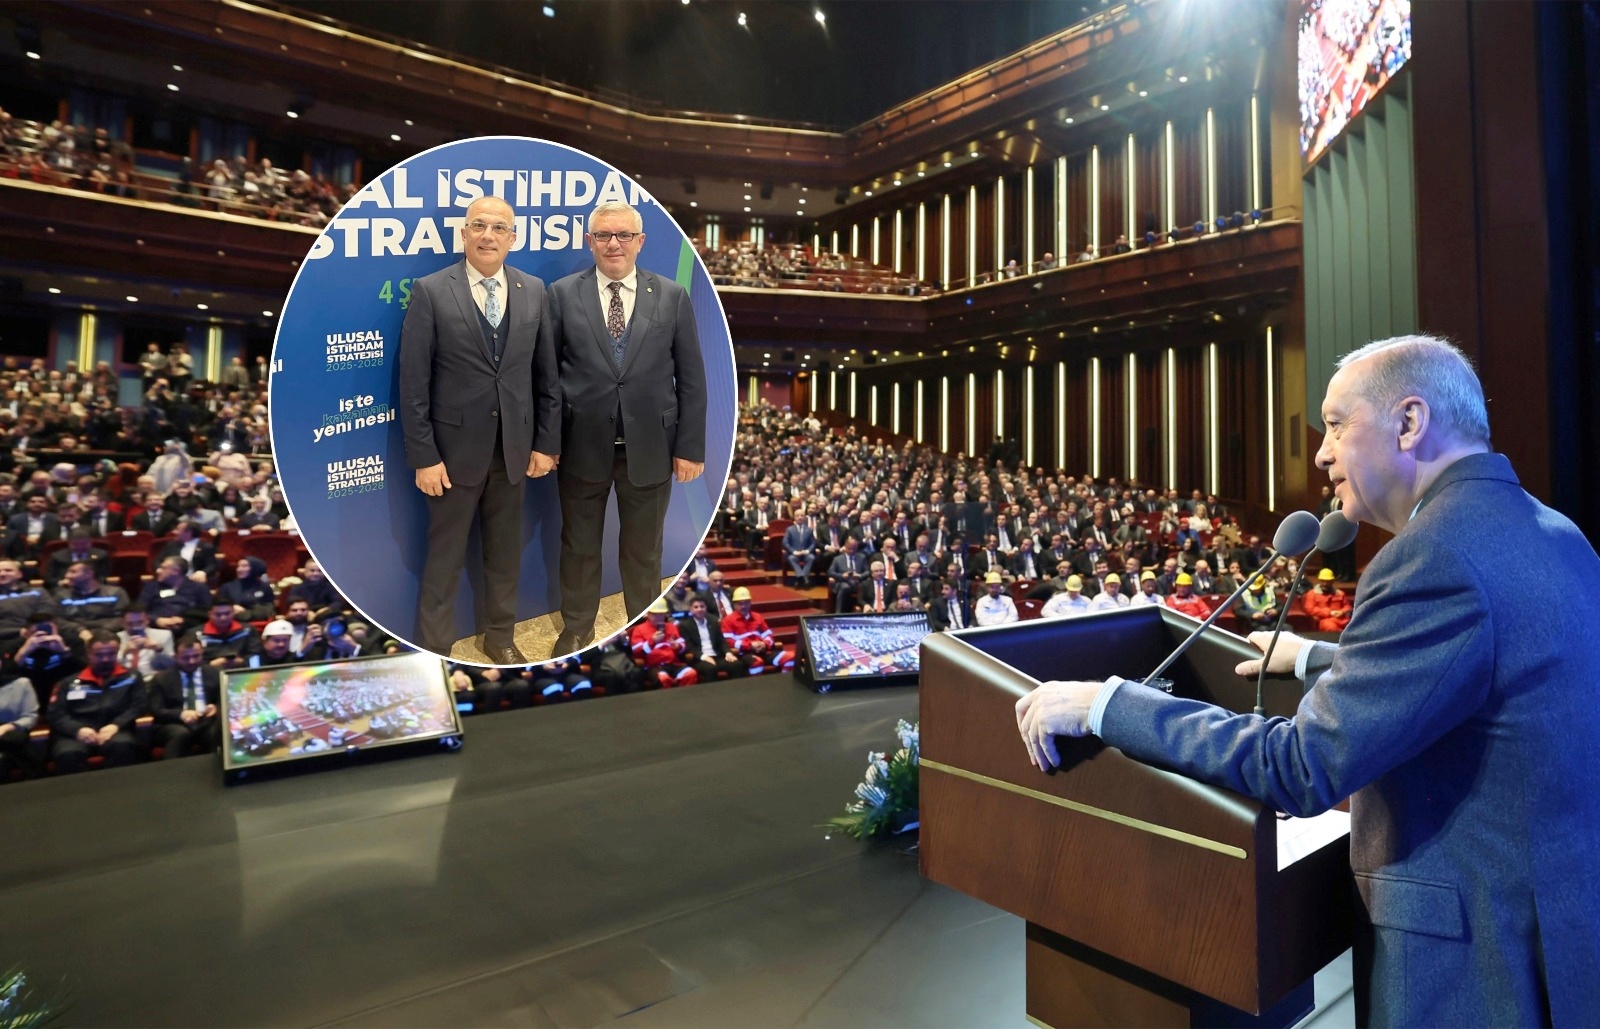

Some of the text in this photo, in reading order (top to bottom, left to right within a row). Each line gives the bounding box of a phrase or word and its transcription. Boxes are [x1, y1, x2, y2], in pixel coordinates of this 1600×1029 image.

[308, 215, 584, 260] STRATJİSİ
[379, 279, 418, 310] 4 Ş
[326, 330, 383, 345] ULUSAL
[326, 358, 384, 372] 2025-2028
[313, 408, 396, 443] yeni nesil
[321, 403, 389, 427] kazanan
[327, 454, 384, 473] ULUSAL
[327, 481, 384, 500] 2025-2028
